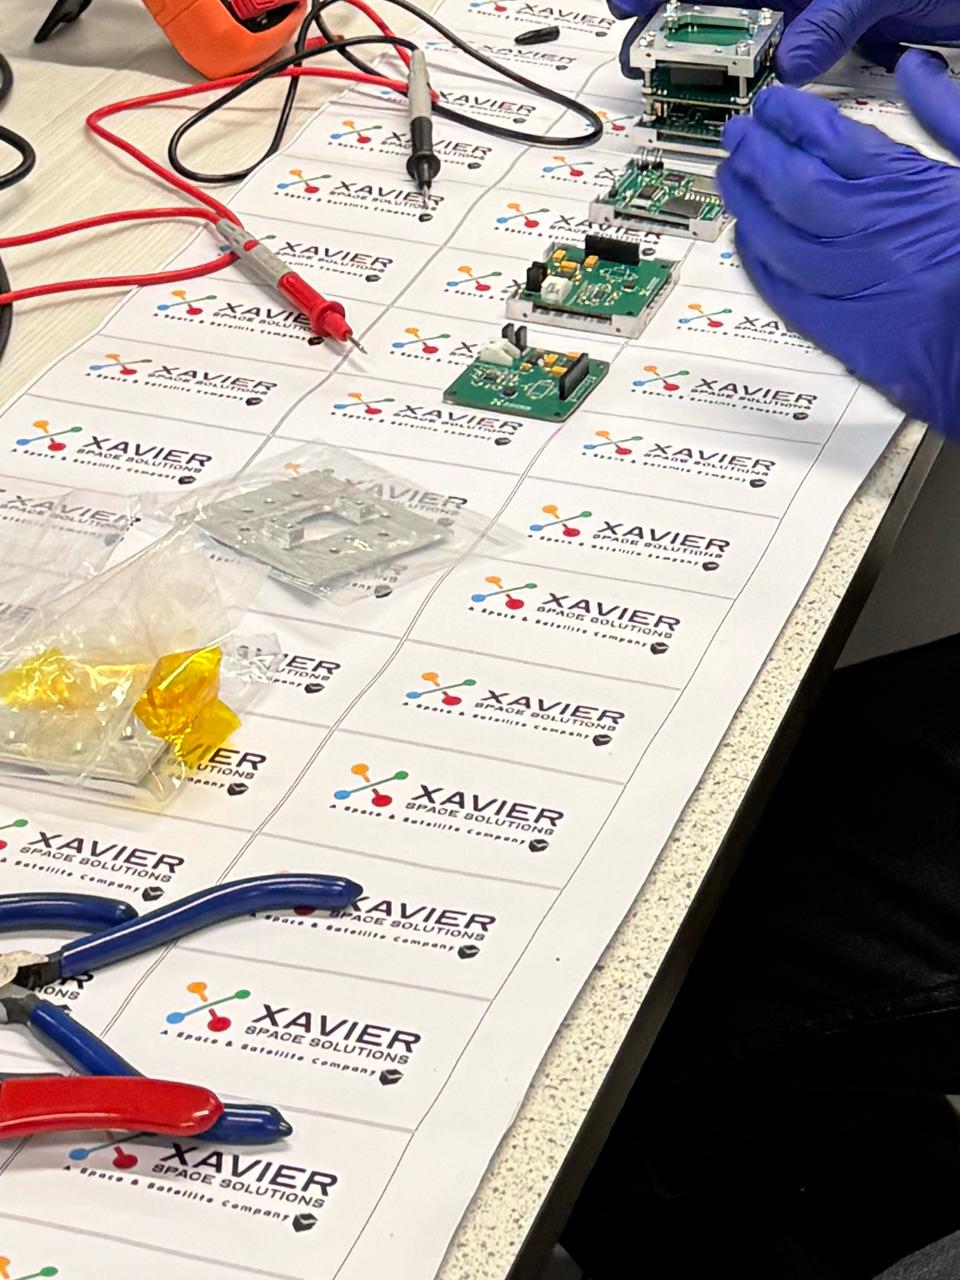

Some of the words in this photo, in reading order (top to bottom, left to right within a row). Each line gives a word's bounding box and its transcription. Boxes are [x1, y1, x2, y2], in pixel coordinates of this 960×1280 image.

[518, 3, 616, 27] XAVIER
[335, 181, 444, 208] XAVIER
[279, 241, 394, 268] XAVIER
[218, 303, 312, 326] XAVIE
[258, 319, 315, 333] SOLUTIO
[153, 366, 277, 391] XAVIER
[696, 378, 817, 404] XAVIER
[396, 405, 523, 433] XAVIER
[84, 436, 212, 467] XAVIER
[649, 444, 776, 471] XAVIER
[598, 521, 730, 552] XAVIER
[537, 606, 585, 621] SPACE
[590, 617, 672, 639] SOLUTIONS
[542, 593, 680, 631] XAVIER
[475, 702, 525, 715] SPACE
[531, 712, 616, 731] SOLUTIONS
[481, 690, 625, 724] XAVIER
[406, 803, 459, 817] SPACE
[464, 813, 554, 835] SOLUTIONS
[411, 784, 564, 827] XAVIER
[20, 847, 76, 862] SPACE
[79, 858, 172, 882] SOLUTIONS
[28, 831, 184, 873] XAVIER
[328, 908, 386, 925] SPACE
[390, 920, 485, 941] SOLUTIONS
[252, 1004, 421, 1053] XAVIER
[245, 1026, 305, 1044] SPACE
[309, 1038, 409, 1064] SOLUTIONS
[152, 1163, 215, 1184] SPACE
[219, 1179, 325, 1208] SOLUTIONS
[159, 1143, 338, 1197] XAVIER
